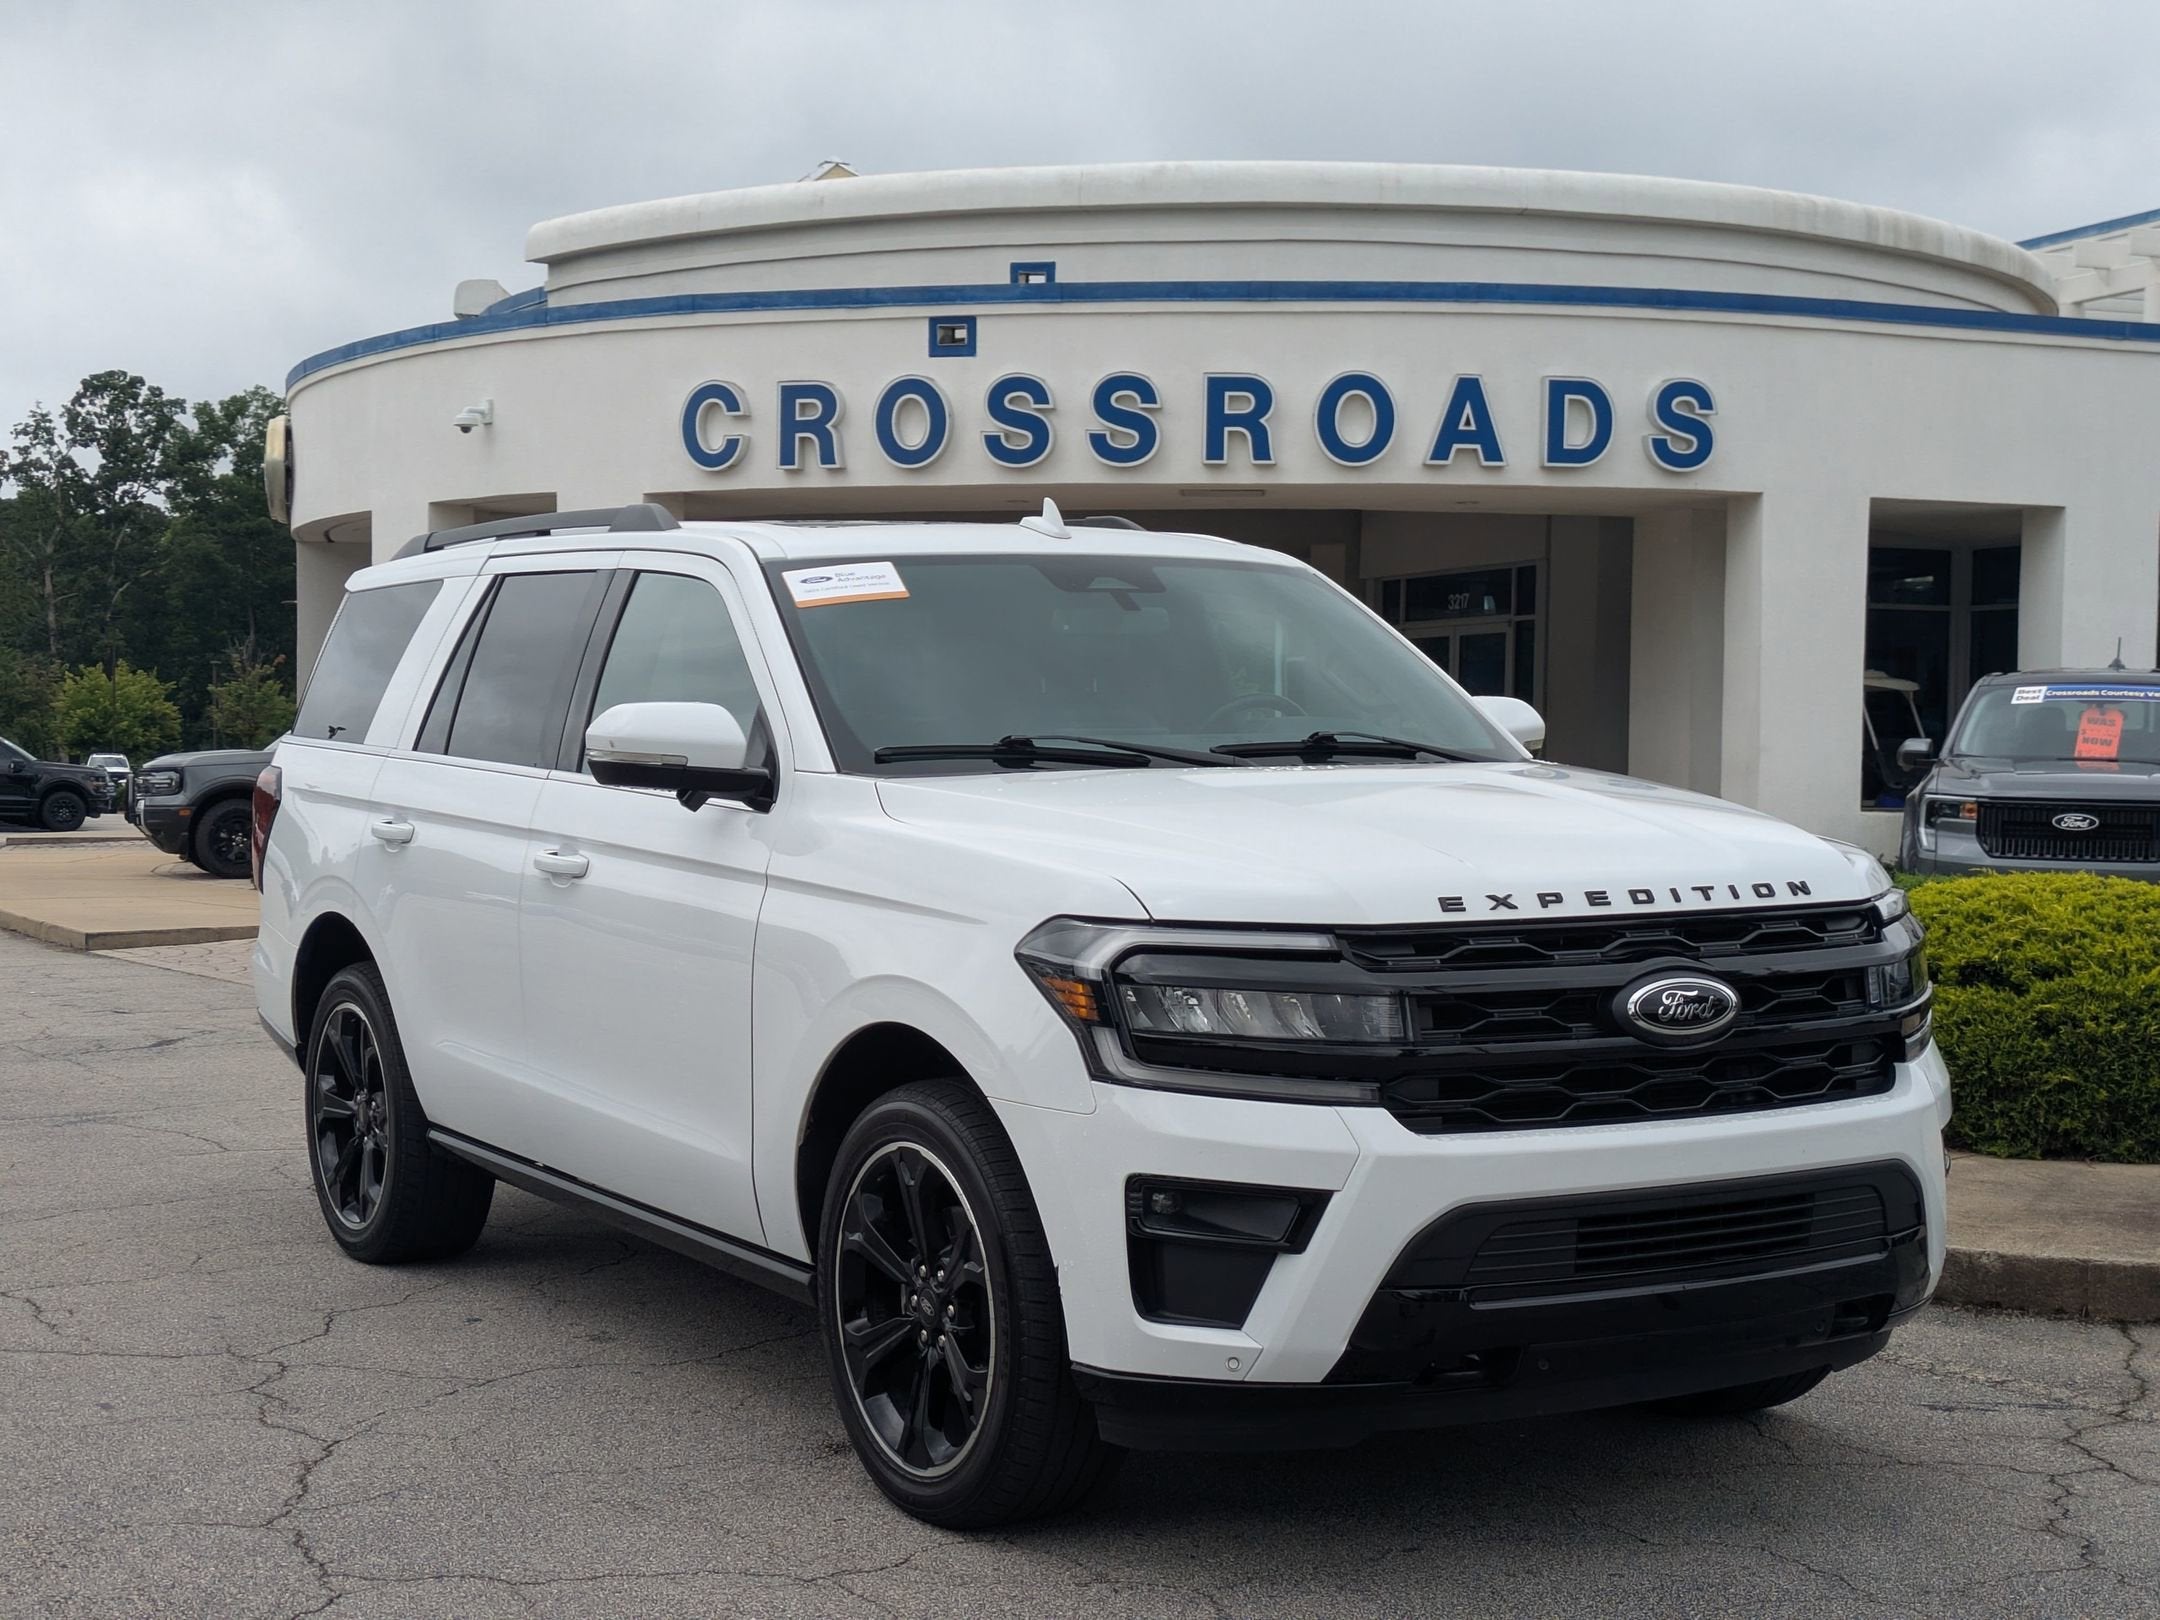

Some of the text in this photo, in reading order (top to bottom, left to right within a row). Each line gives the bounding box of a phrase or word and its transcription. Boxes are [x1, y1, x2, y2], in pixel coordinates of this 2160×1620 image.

[680, 370, 1717, 473] CROSSROADS
[1447, 592, 1470, 611] 3217
[2100, 689, 2145, 697] Courtesy
[2081, 736, 2112, 747] NOW
[2060, 816, 2091, 828] Ford
[1437, 880, 1812, 913] EXPEDITION
[1658, 990, 1715, 1021] Ford
